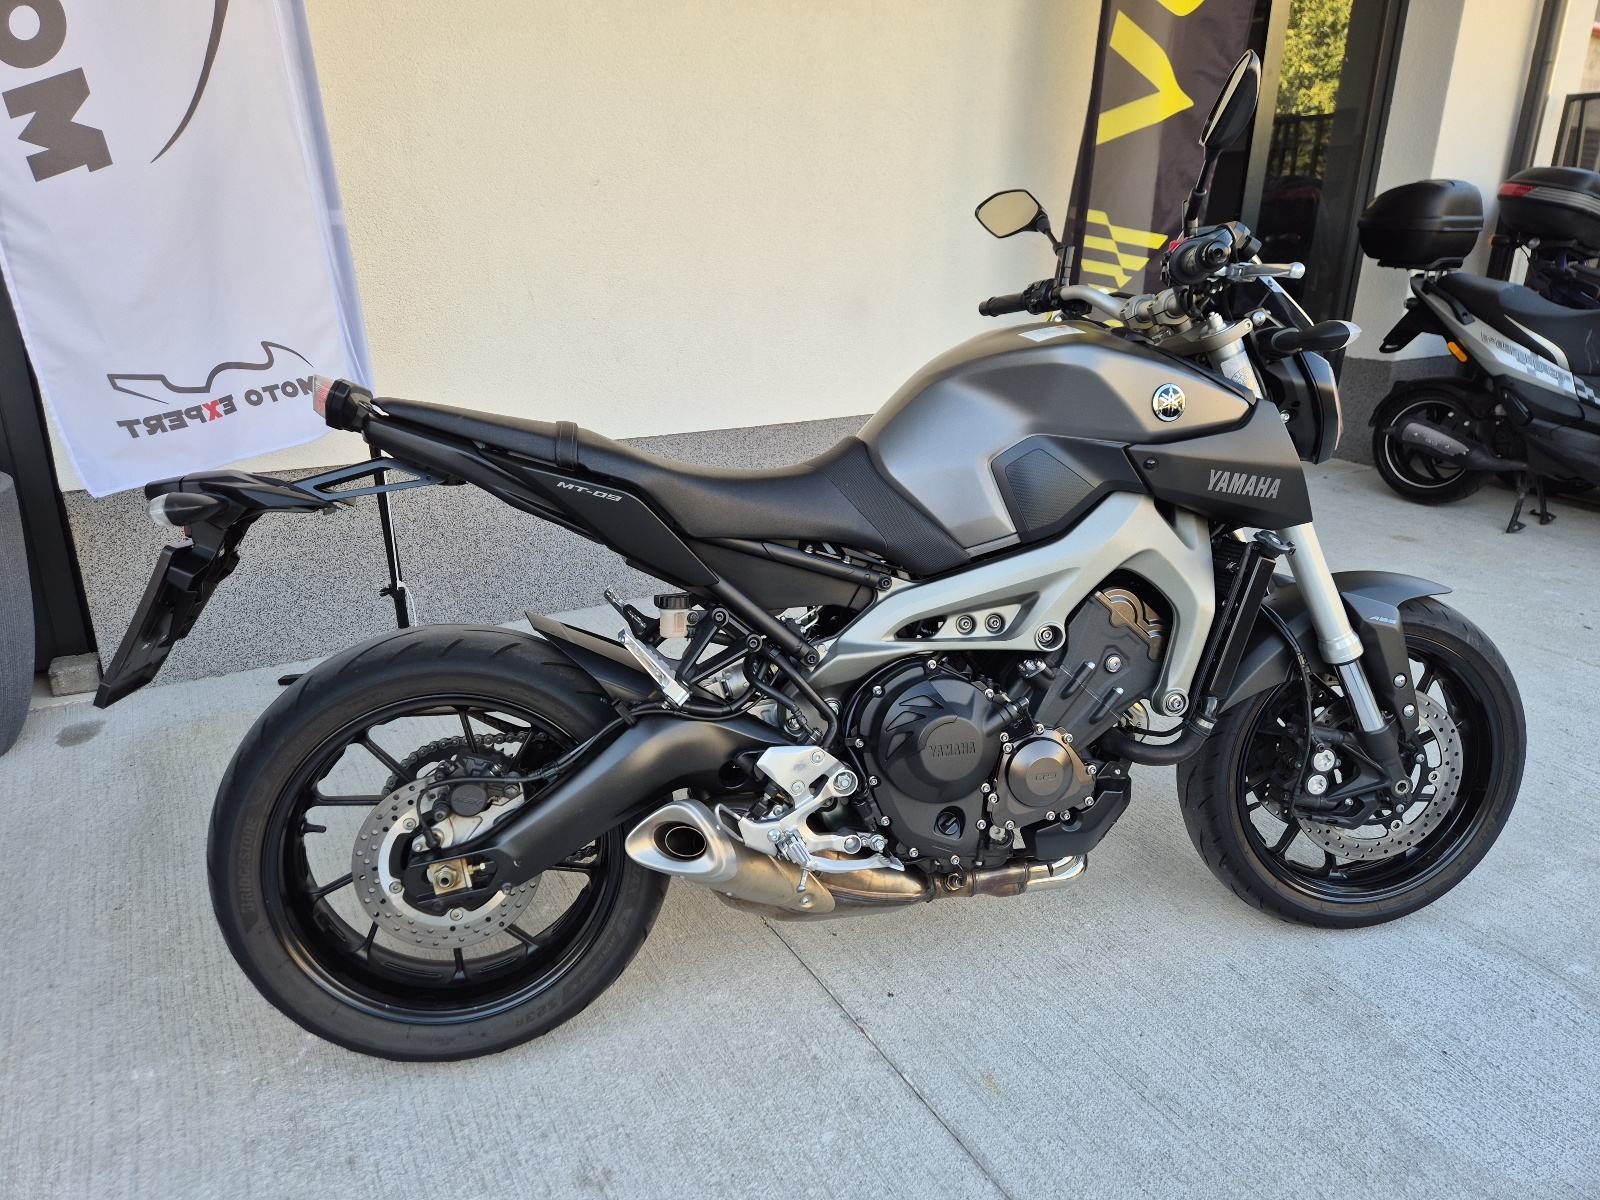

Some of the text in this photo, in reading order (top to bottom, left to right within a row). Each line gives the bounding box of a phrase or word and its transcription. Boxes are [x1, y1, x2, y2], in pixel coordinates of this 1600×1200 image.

[557, 481, 622, 502] MT-09
[1207, 469, 1281, 499] YAMAHA
[928, 742, 976, 758] YAMAHA
